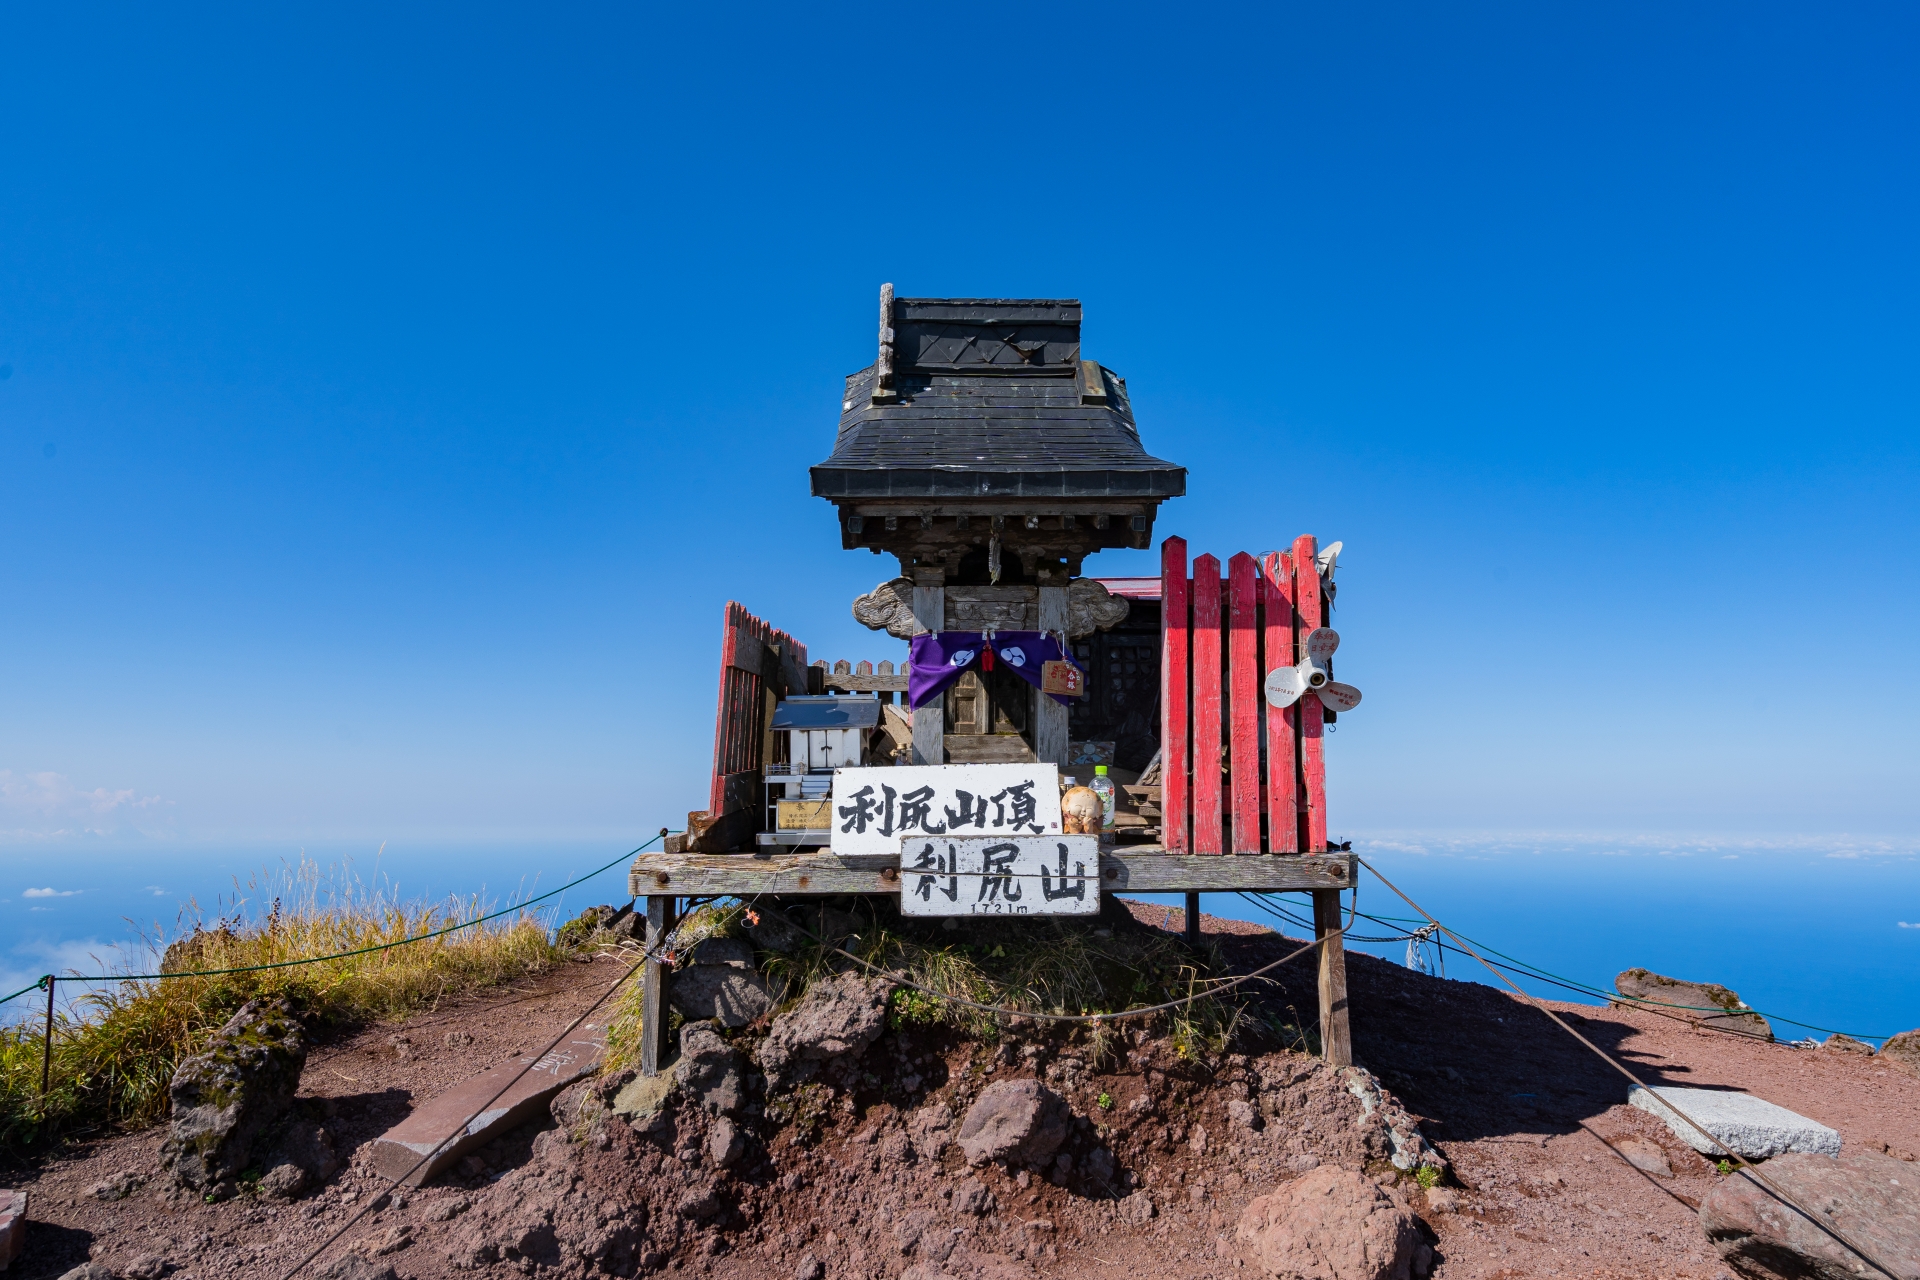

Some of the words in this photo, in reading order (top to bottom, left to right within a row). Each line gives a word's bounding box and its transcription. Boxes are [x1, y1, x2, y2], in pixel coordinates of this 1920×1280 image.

[1066, 671, 1076, 690] 合格
[838, 779, 1046, 838] 利尻山頂
[912, 842, 1086, 902] 利尻山
[970, 903, 1028, 914] 1721m
